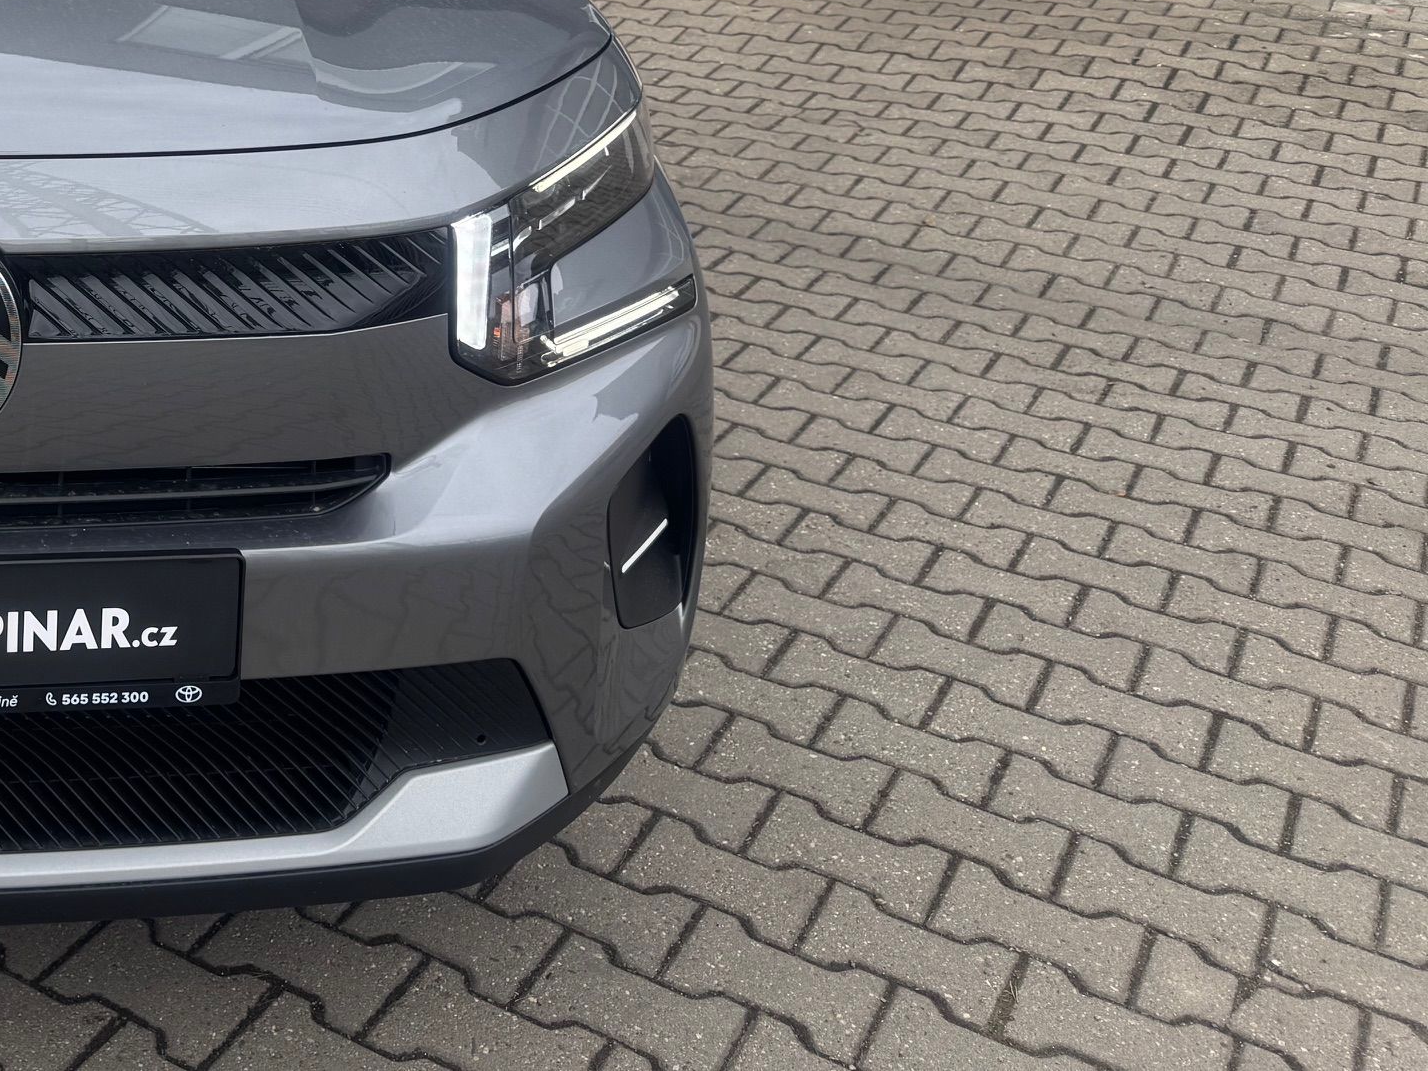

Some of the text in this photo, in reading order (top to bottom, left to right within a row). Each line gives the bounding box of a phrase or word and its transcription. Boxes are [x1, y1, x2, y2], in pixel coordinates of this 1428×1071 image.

[61, 693, 89, 706] 565
[91, 692, 118, 705] 552
[121, 691, 149, 704] 300
